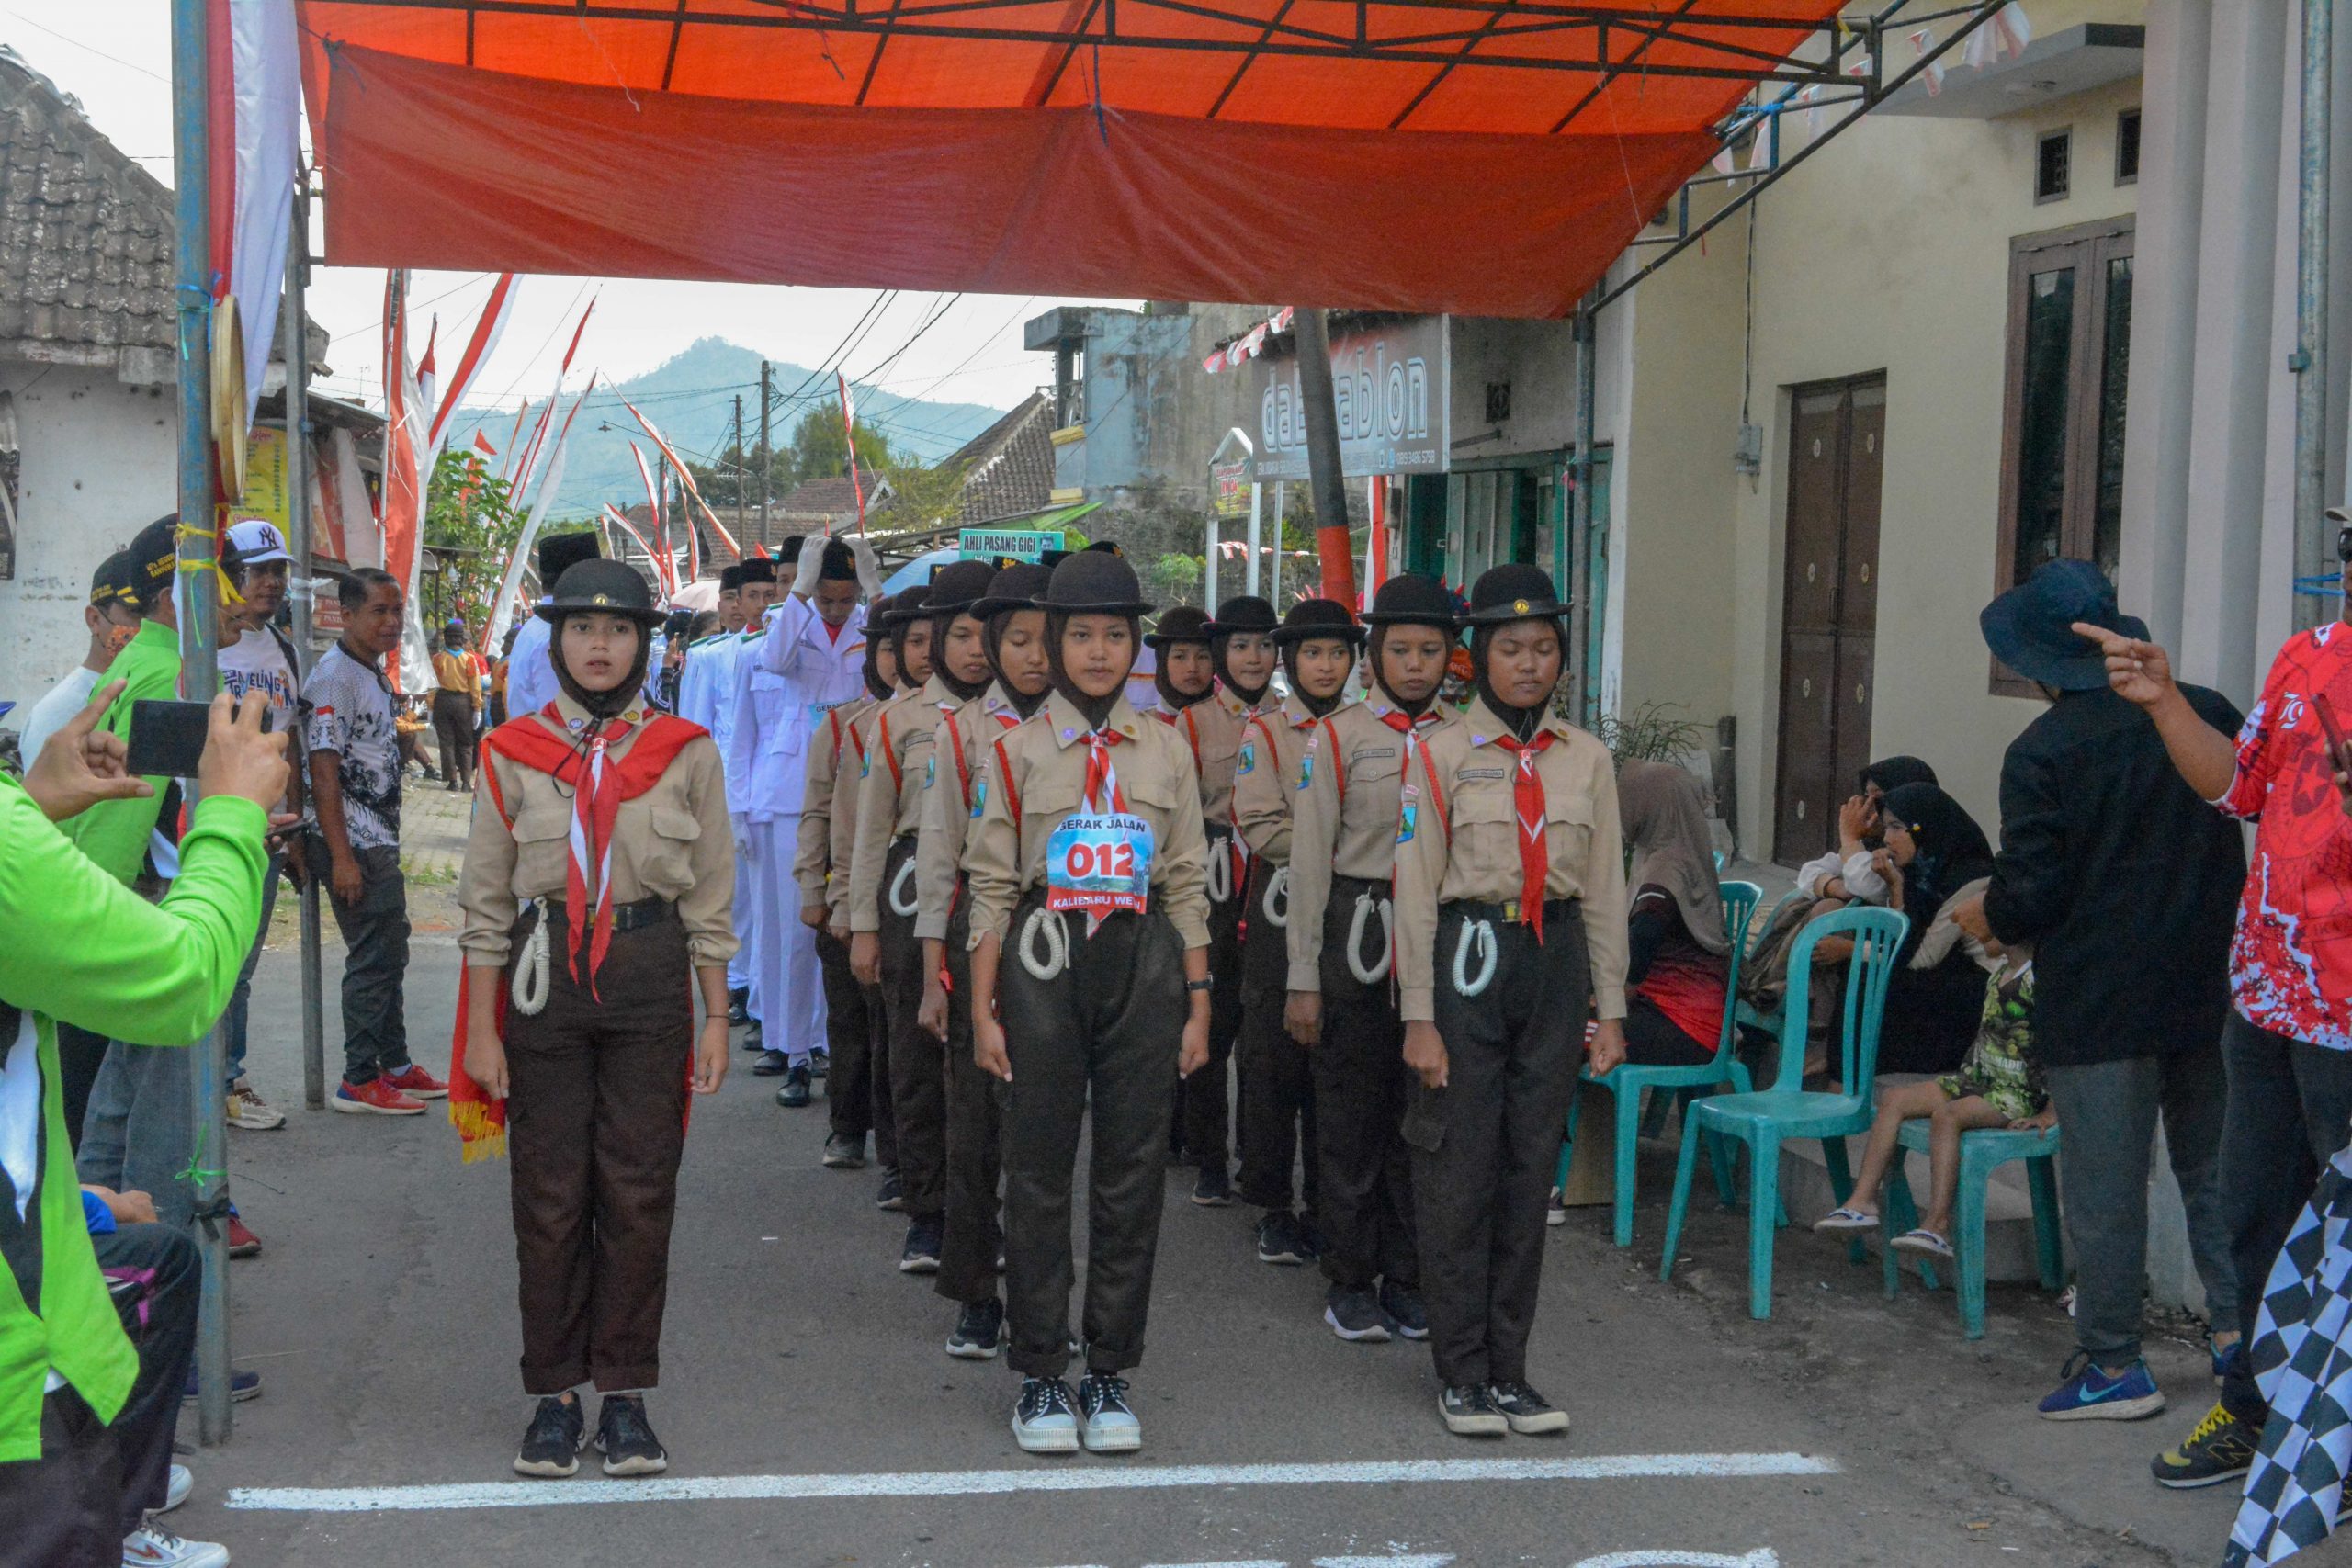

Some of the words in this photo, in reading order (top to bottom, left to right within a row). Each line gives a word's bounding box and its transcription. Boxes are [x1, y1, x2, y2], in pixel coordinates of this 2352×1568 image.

[1333, 341, 1428, 442] ablon
[964, 535, 982, 551] AHLI
[984, 536, 1016, 552] PASANG
[1018, 537, 1036, 553] GIGI
[1059, 819, 1102, 831] GERAK
[1106, 818, 1146, 832] JALAN
[1066, 843, 1135, 878] 012
[1053, 896, 1112, 908] KALIBARU
